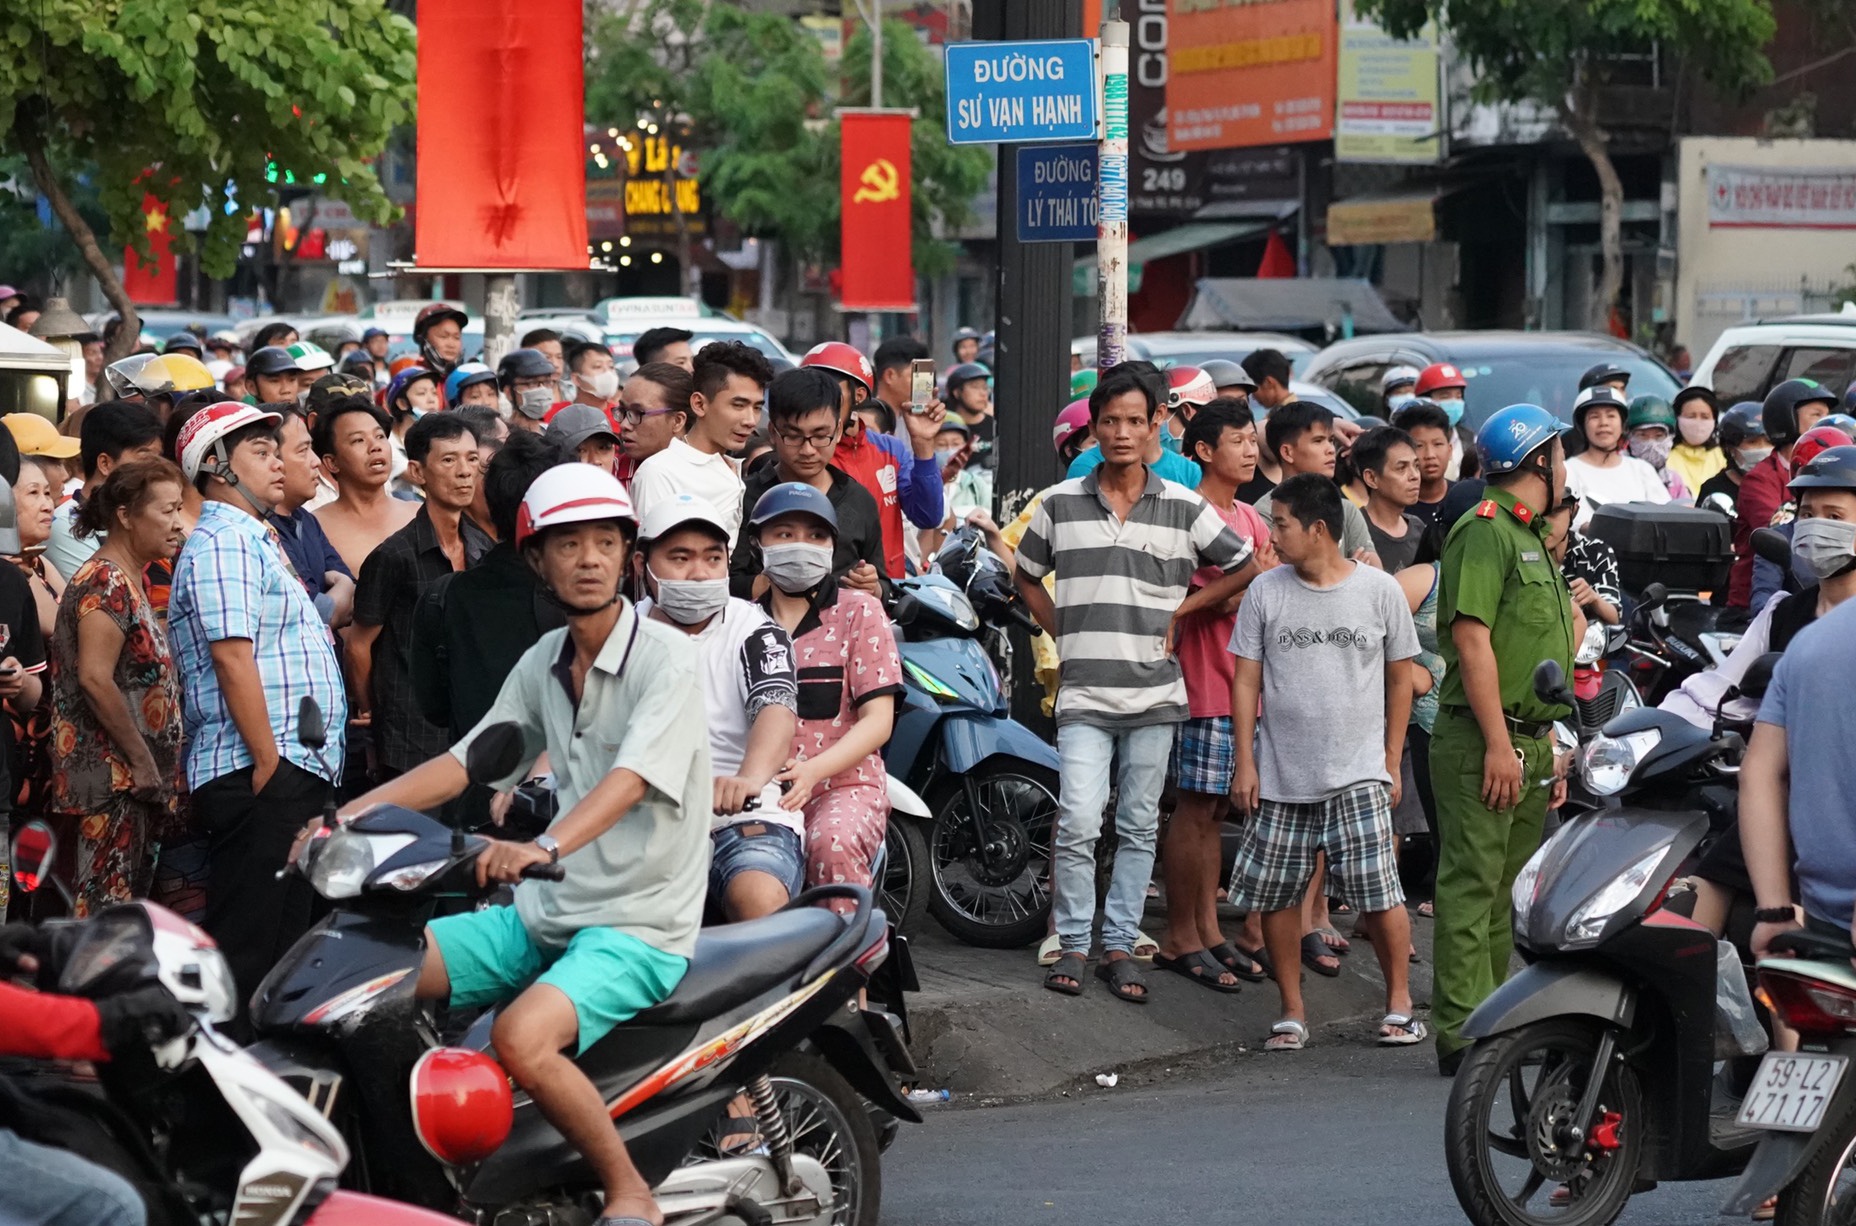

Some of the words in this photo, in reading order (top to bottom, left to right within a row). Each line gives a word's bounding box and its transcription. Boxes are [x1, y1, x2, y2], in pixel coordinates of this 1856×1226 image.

[974, 52, 1064, 83] ĐƯỜNG
[958, 93, 983, 129] SƯ
[989, 97, 1024, 133] VẠN
[1032, 95, 1082, 131] HẠNH
[1034, 154, 1092, 183] ĐƯỜNG
[1143, 167, 1187, 191] 249
[1028, 190, 1044, 227] LÝ
[1048, 190, 1078, 227] THÁI
[1277, 634, 1310, 645] JEANS
[1312, 630, 1324, 644] &
[1327, 633, 1368, 644] DESIGN
[1664, 635, 1699, 660] SUZUKI
[1745, 1091, 1824, 1126] 471.17
